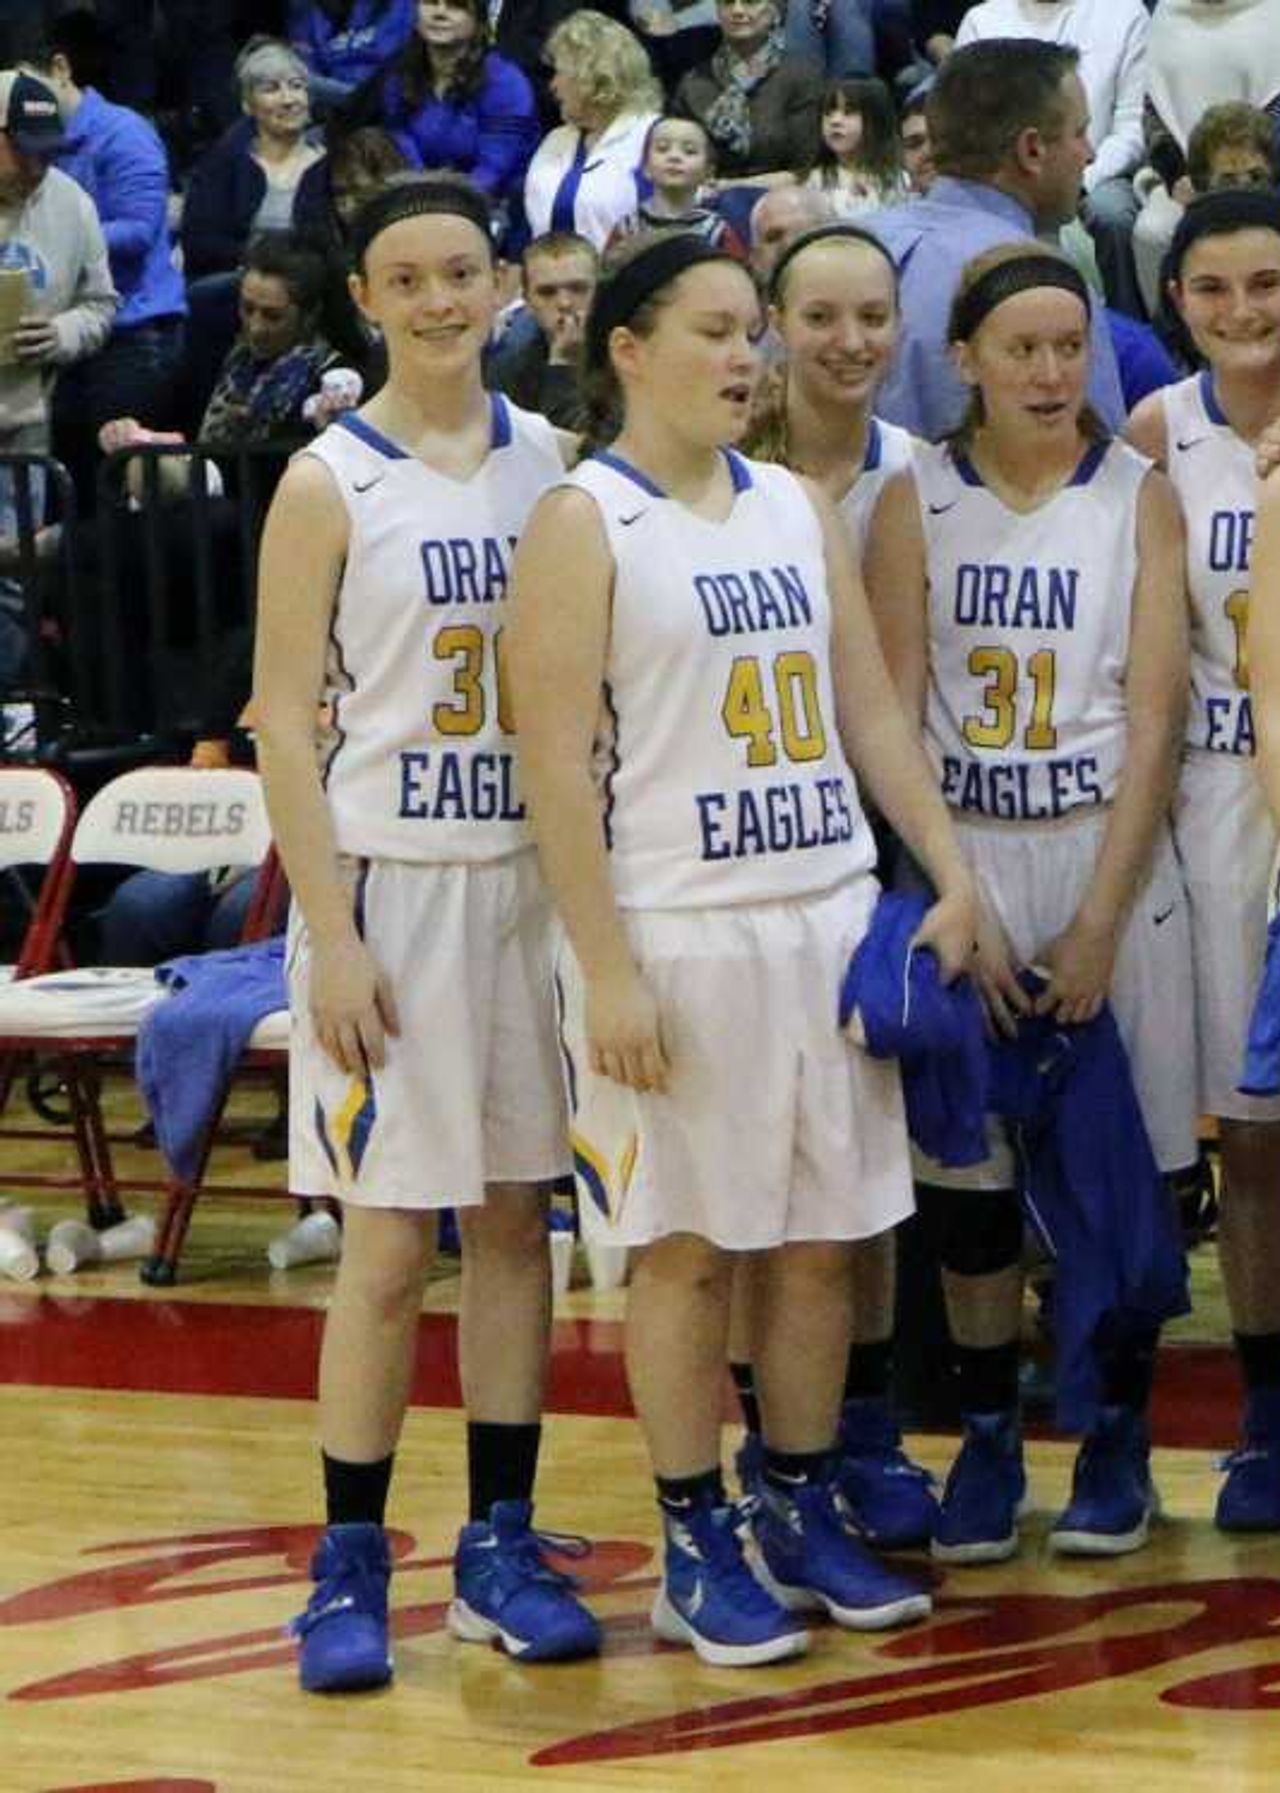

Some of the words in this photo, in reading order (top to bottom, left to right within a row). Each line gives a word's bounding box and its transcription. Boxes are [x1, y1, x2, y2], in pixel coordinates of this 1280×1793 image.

[420, 536, 517, 605] ORA
[693, 565, 814, 637] ORAN
[955, 563, 1081, 630] ORAN
[722, 651, 827, 768] 40
[962, 646, 1057, 750] 31
[114, 801, 247, 837] REBELS
[696, 779, 855, 861] EAGLES
[941, 757, 1103, 821] EAGLES
